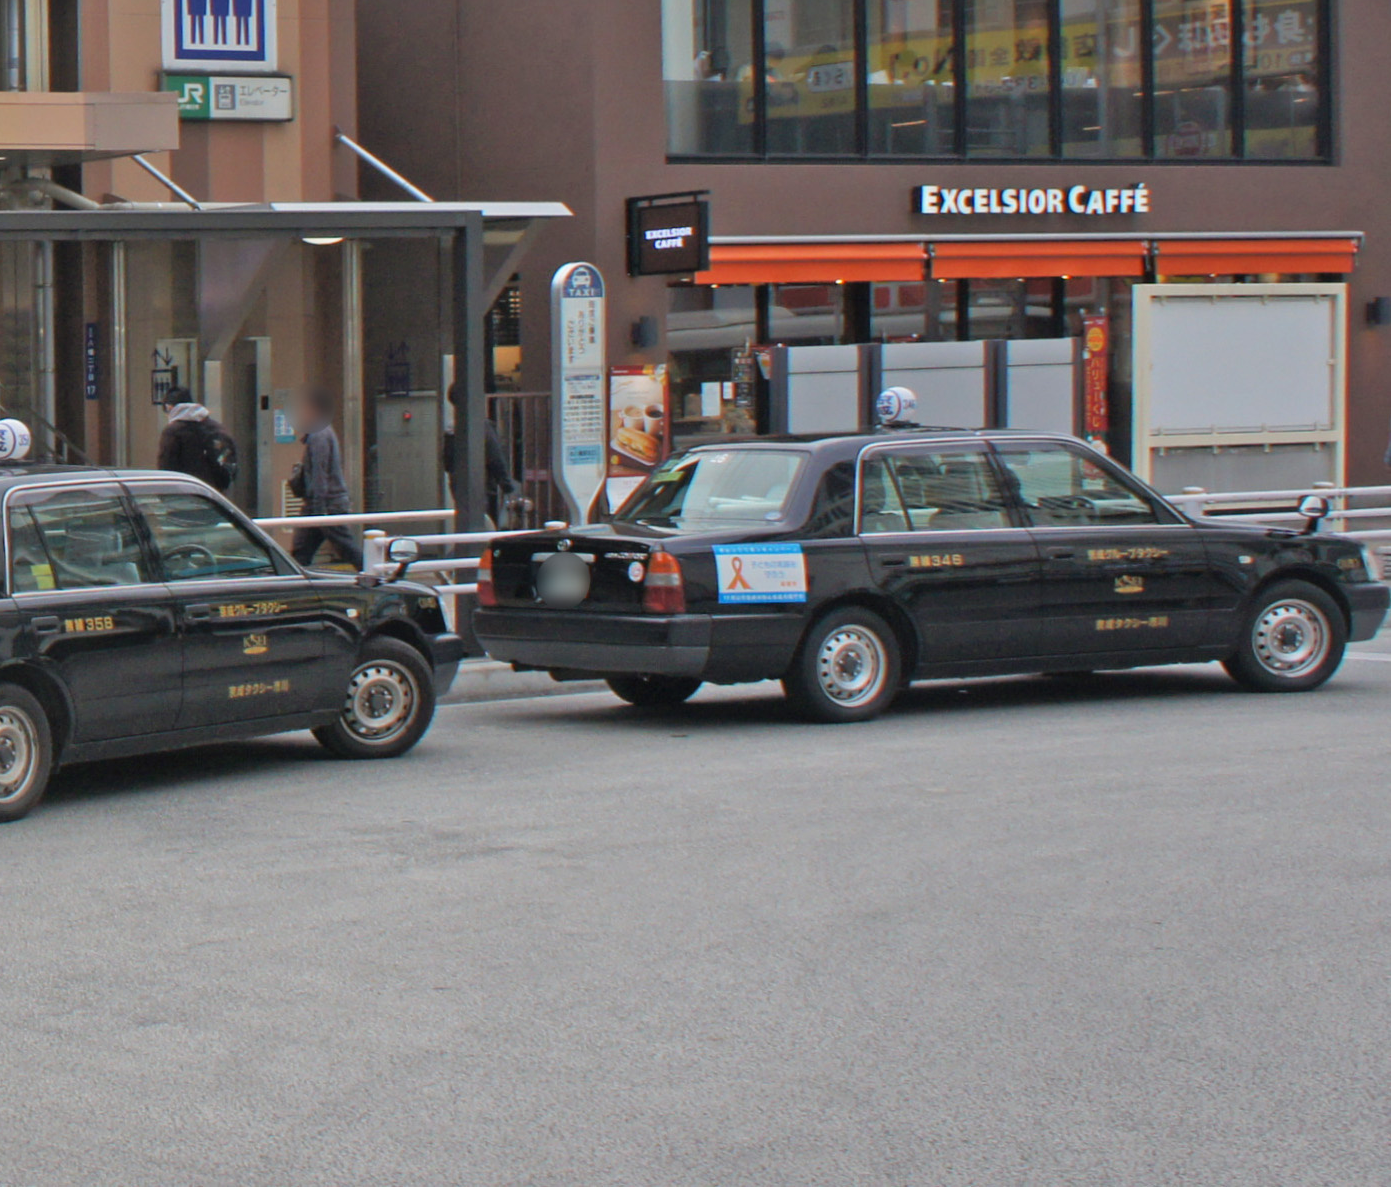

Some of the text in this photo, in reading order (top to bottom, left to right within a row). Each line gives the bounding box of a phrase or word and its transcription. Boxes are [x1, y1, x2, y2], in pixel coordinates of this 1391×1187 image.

[177, 82, 204, 104] JR
[239, 85, 288, 97] エレベーター
[920, 183, 1150, 215] EXCELSIOR CAFFÉ
[644, 227, 694, 240] EXCELSIOR
[568, 288, 594, 297] TAXI
[87, 385, 96, 395] 17
